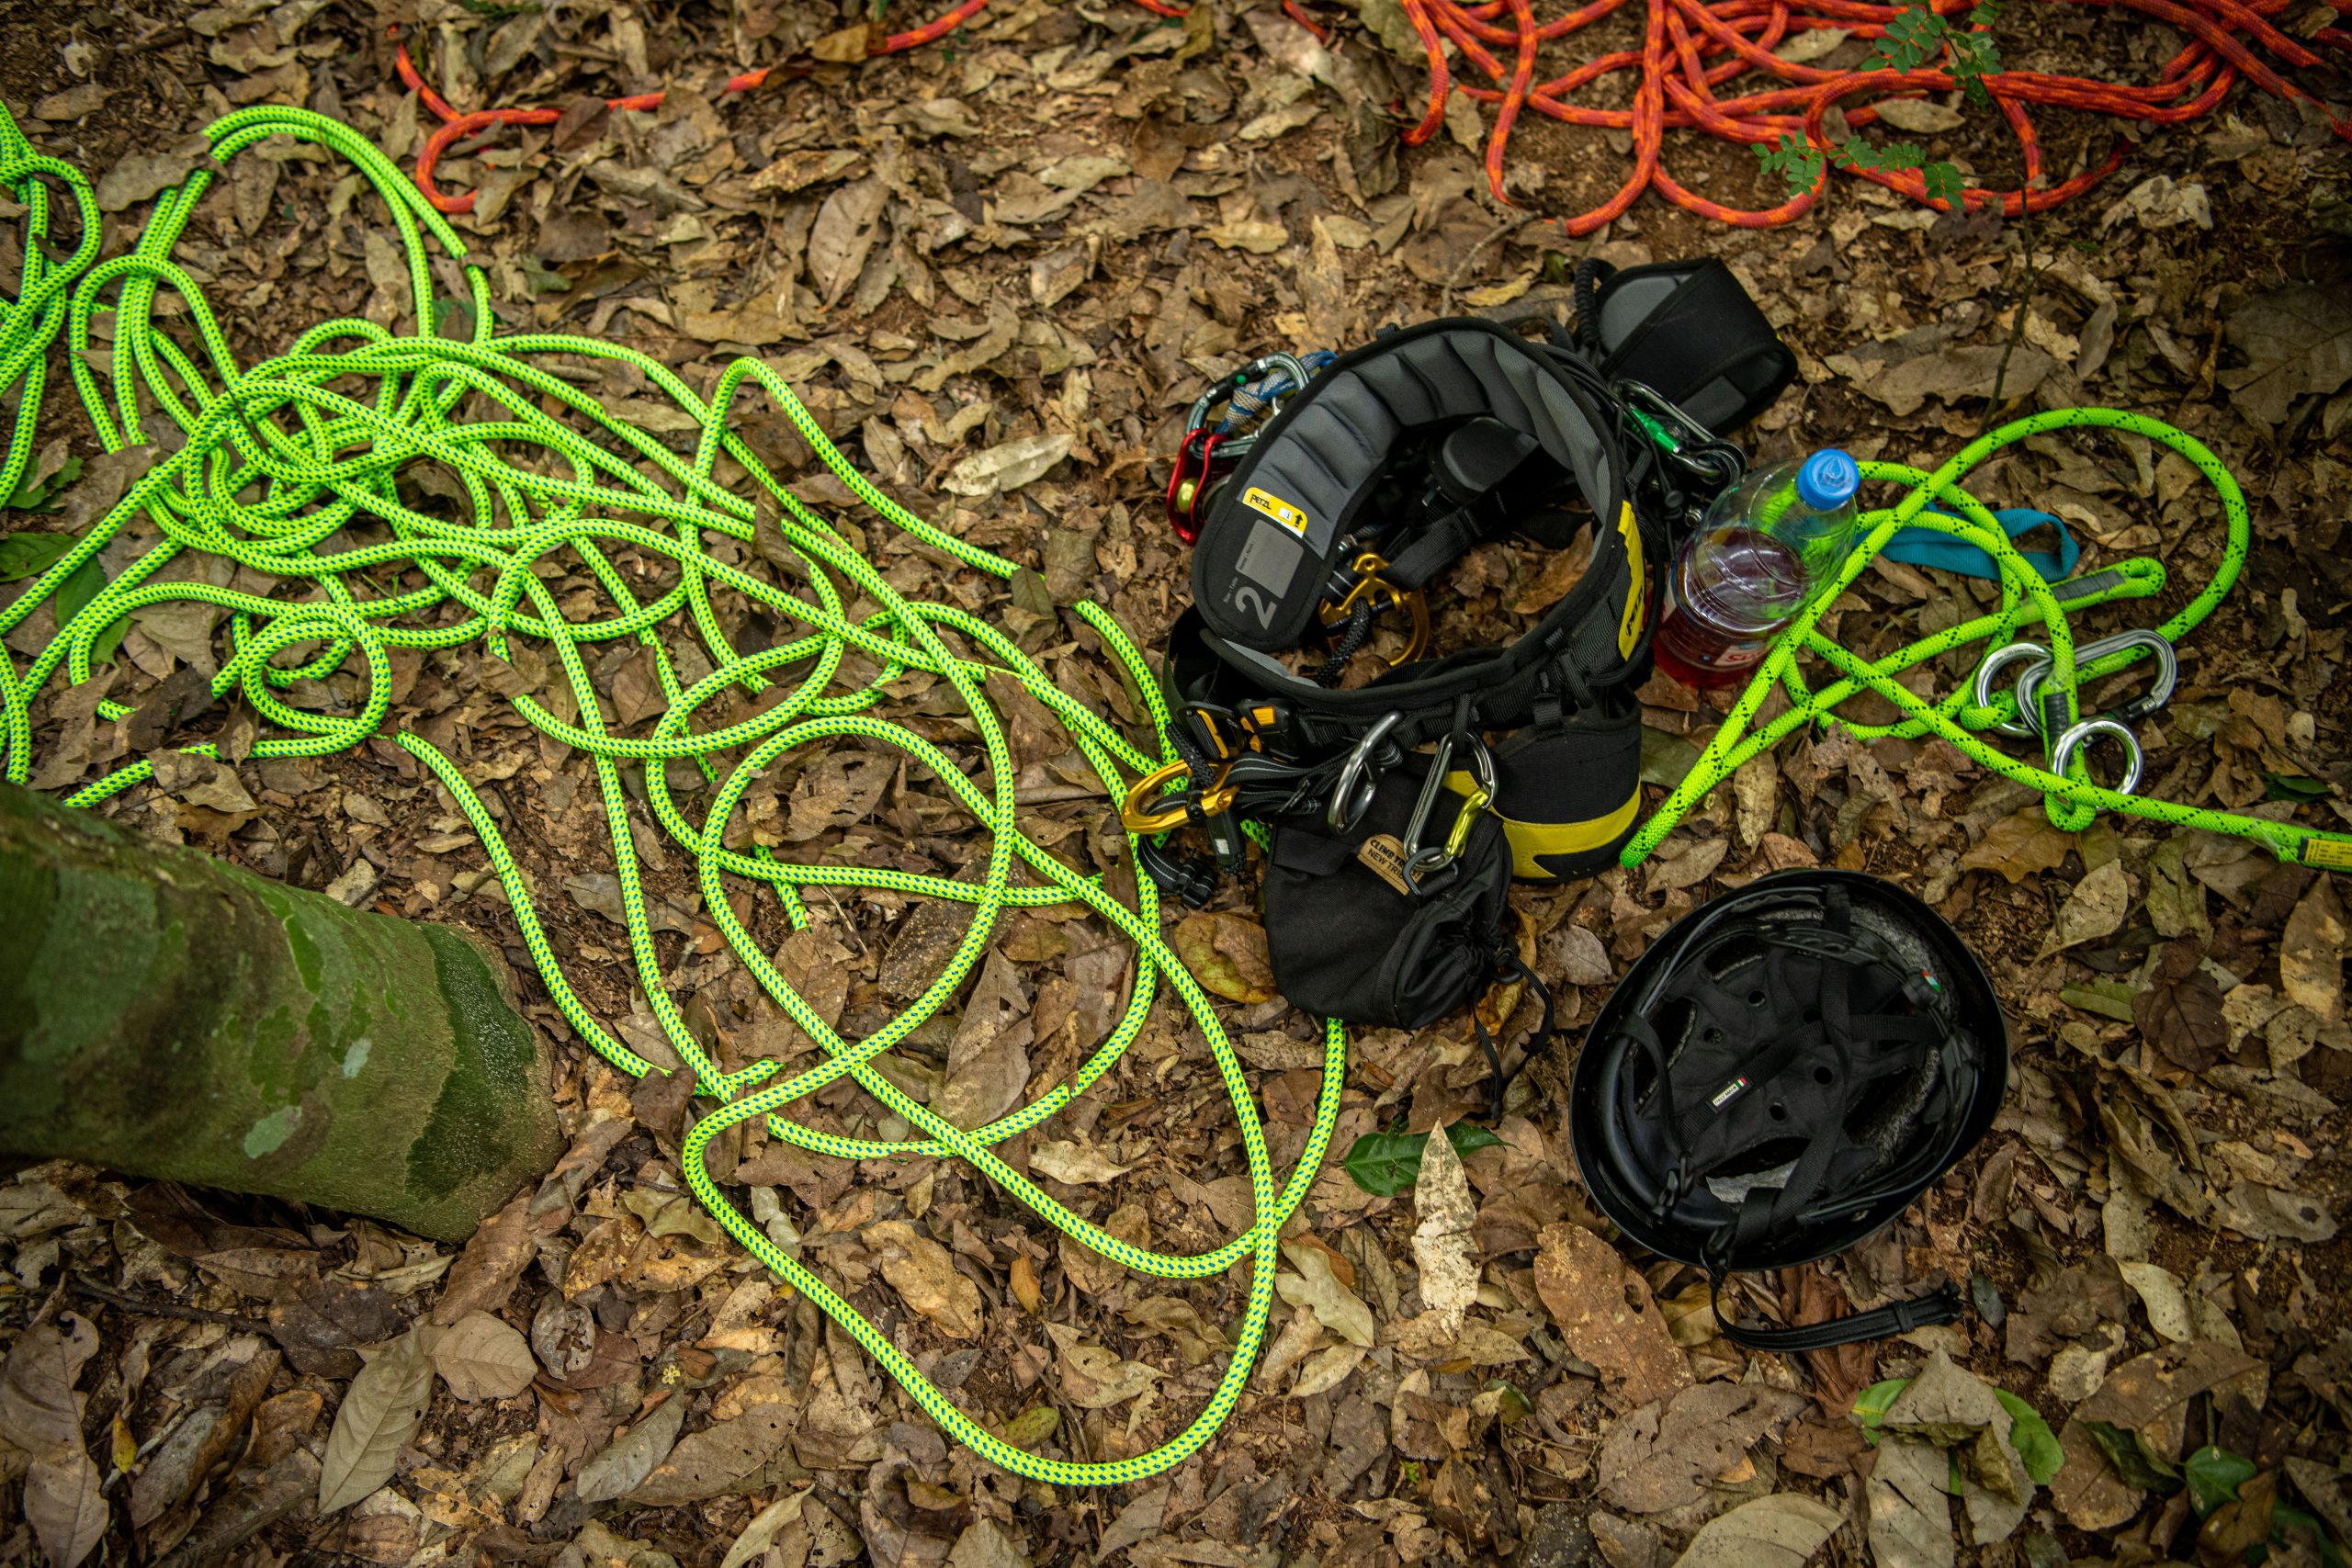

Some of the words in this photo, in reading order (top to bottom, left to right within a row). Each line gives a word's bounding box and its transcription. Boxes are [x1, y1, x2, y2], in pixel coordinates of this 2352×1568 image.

[1250, 493, 1272, 510] PETZL
[1235, 586, 1277, 631] 2
[1367, 849, 1388, 864] NEW
[1370, 839, 1396, 860] CLIMB
